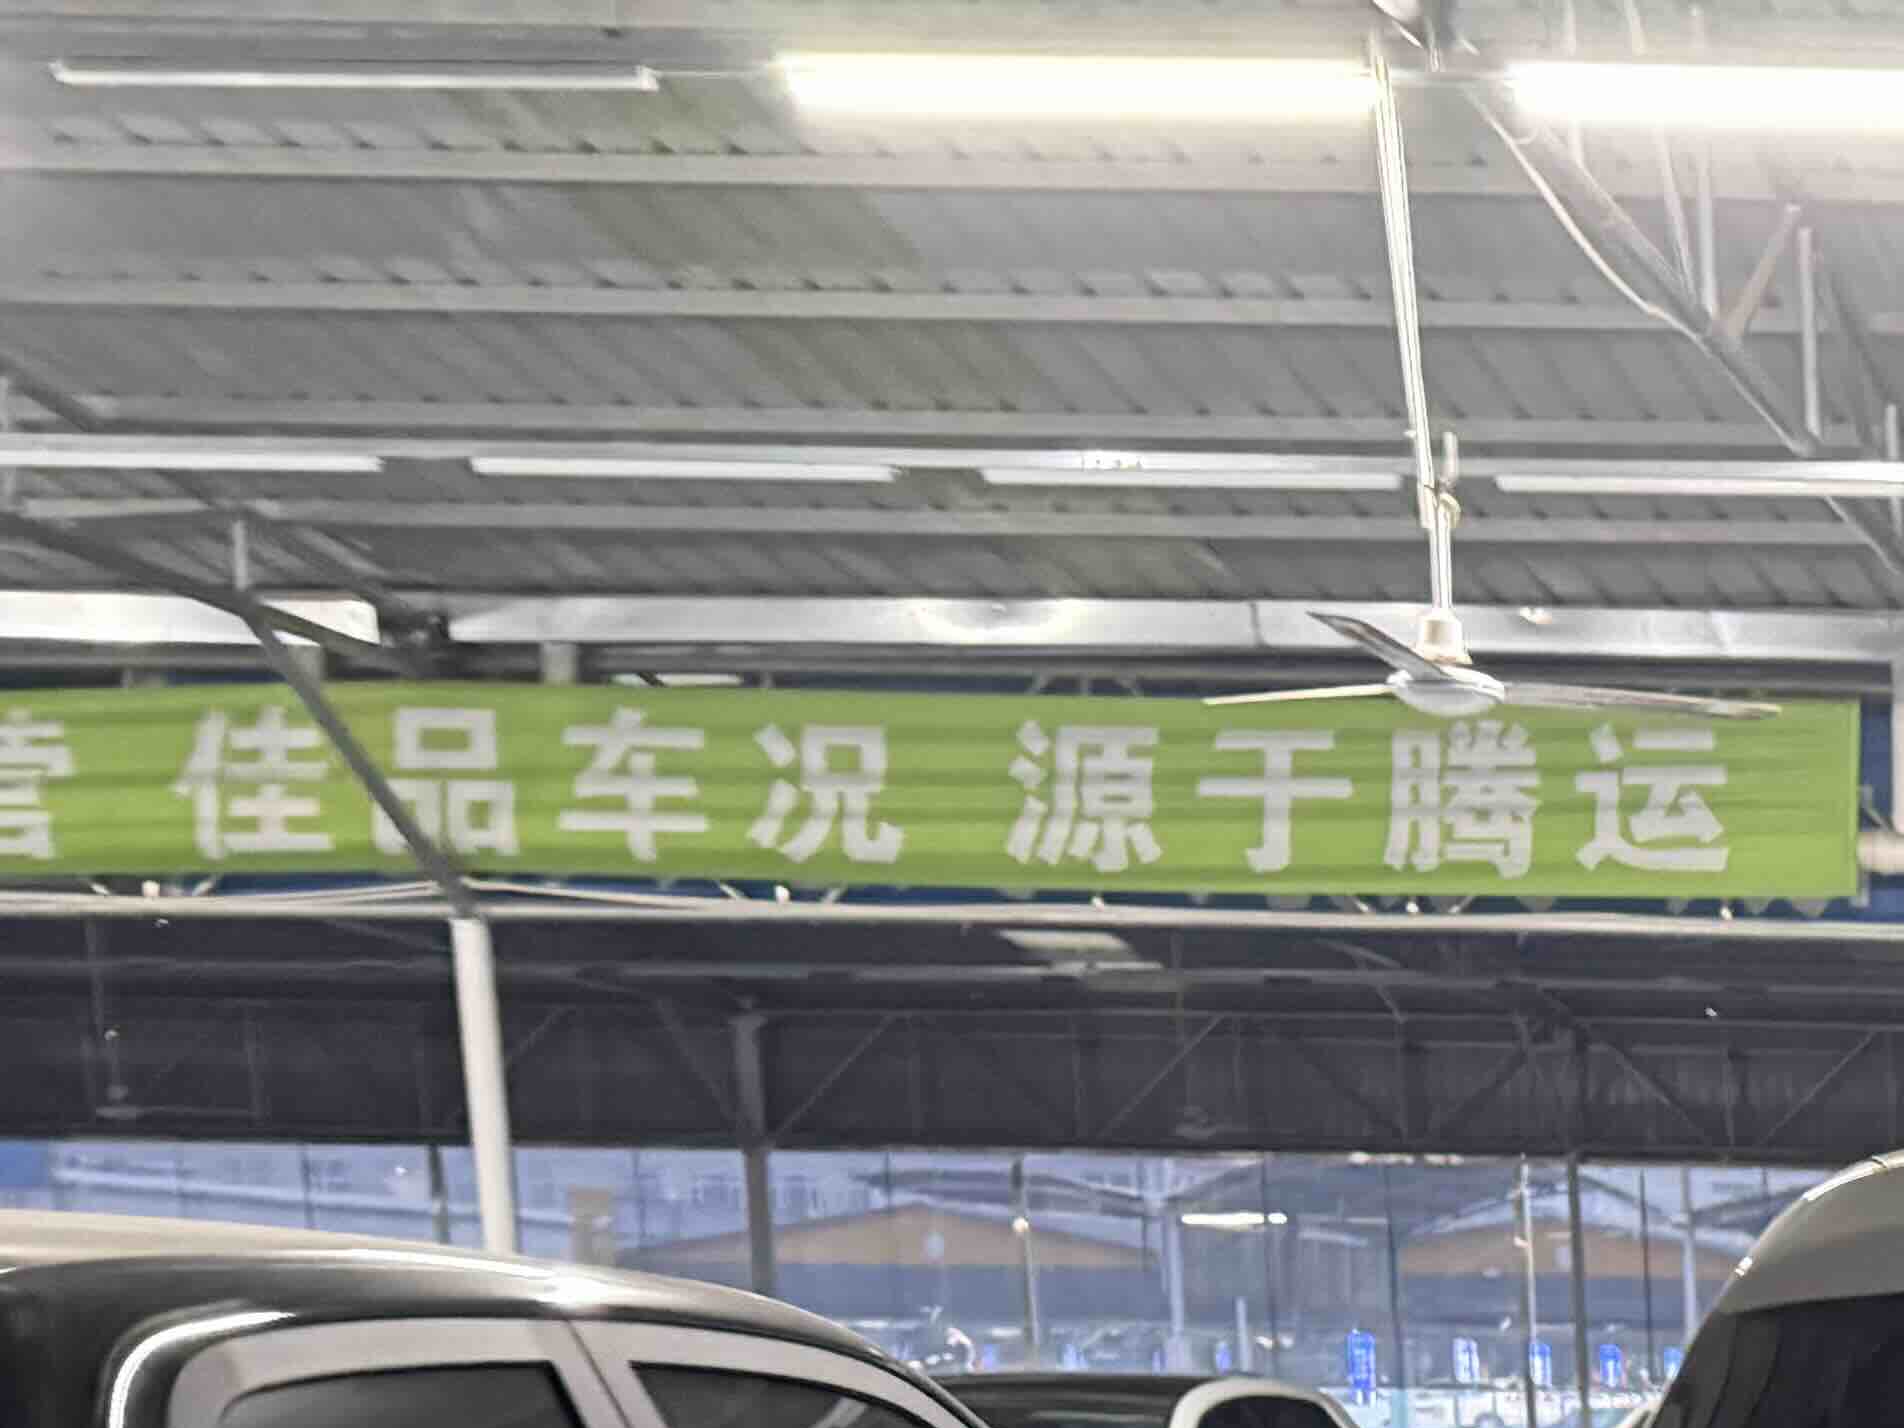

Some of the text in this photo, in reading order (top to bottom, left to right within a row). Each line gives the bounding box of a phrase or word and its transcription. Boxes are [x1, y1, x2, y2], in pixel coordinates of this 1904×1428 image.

[172, 705, 905, 866] 佳品车况
[1007, 720, 1731, 879] 源于腾运
